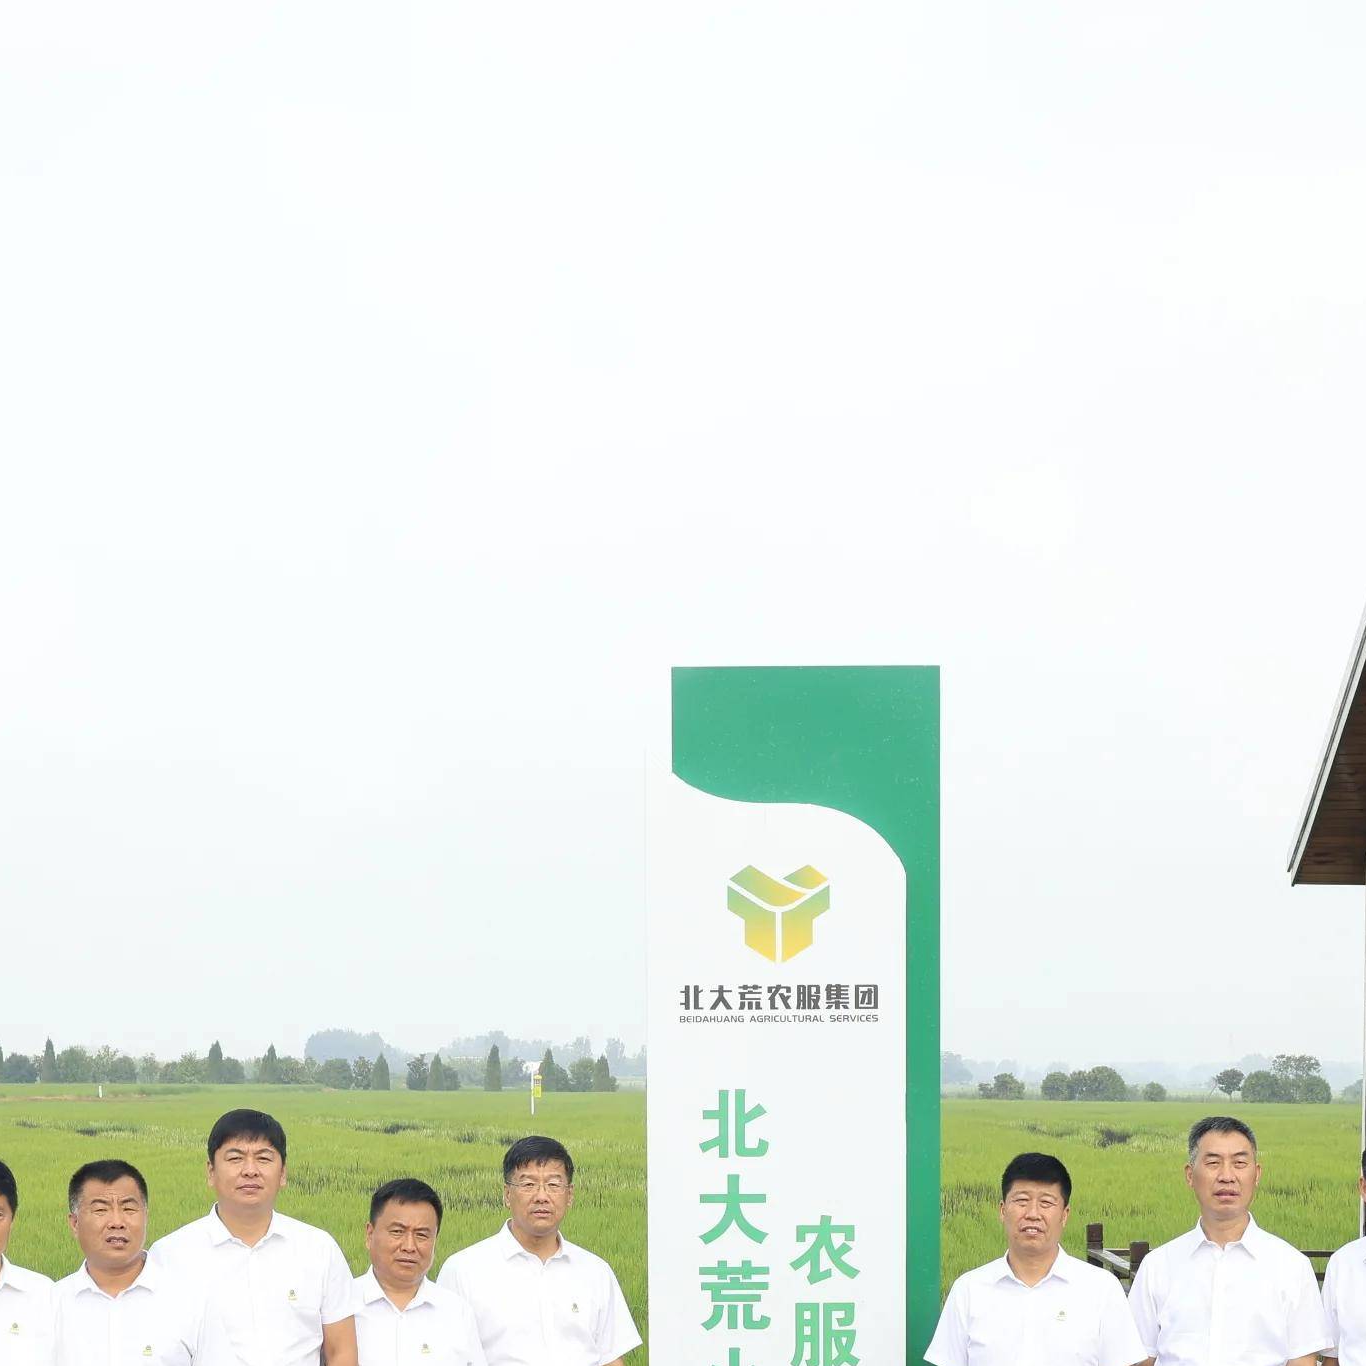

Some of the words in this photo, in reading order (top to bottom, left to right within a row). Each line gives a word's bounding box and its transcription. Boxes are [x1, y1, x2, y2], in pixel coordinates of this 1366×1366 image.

[679, 984, 879, 1010] 北大荒农服集团
[679, 1015, 745, 1023] BEIDAHUANG
[749, 1015, 825, 1023] AGRICULTURAL
[829, 1015, 879, 1023] SERVICES
